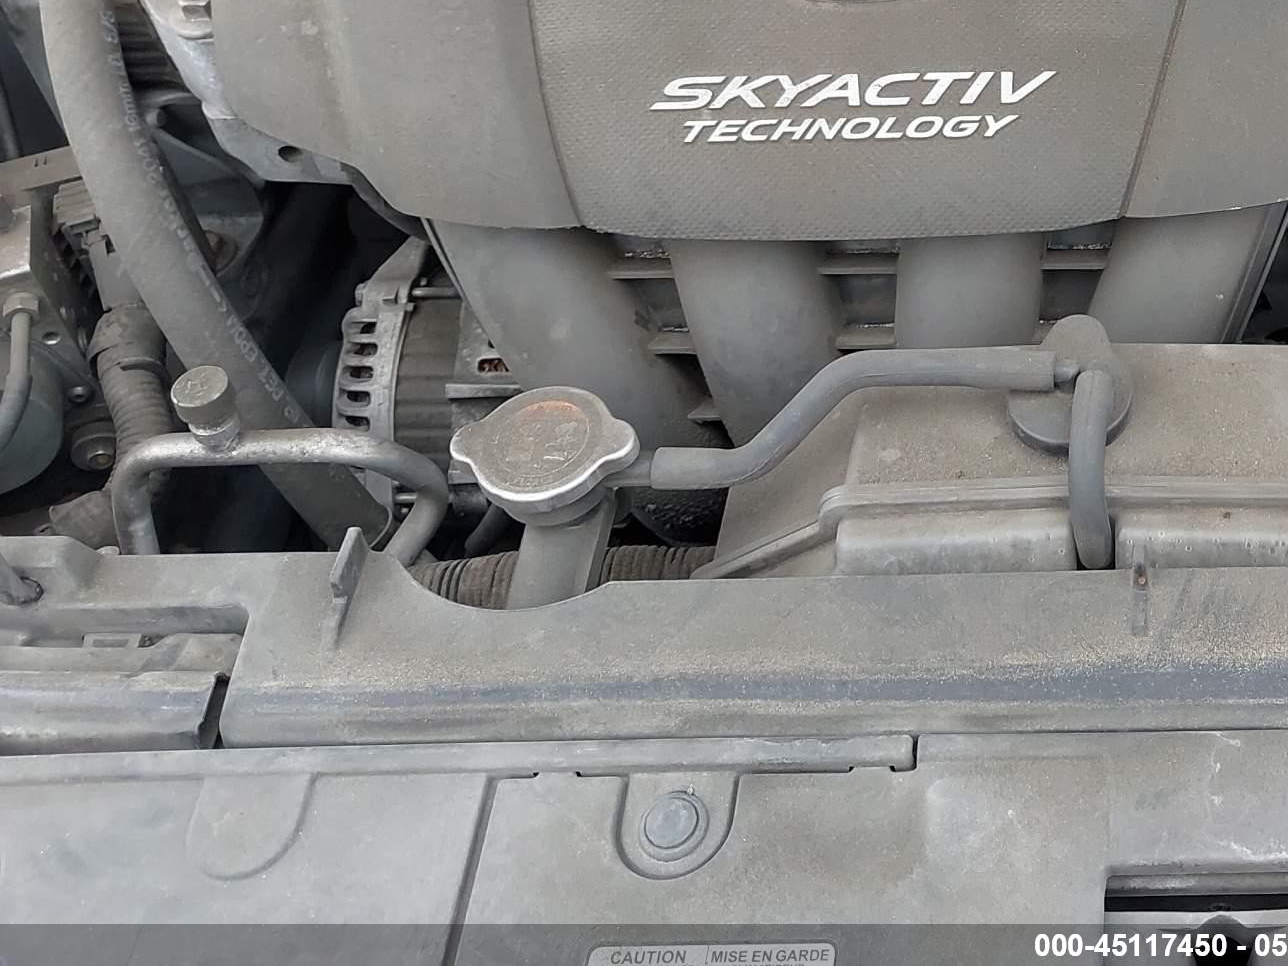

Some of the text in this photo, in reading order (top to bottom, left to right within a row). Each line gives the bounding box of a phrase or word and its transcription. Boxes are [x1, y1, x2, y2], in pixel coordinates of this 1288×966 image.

[650, 70, 1057, 111] SKYACTIV
[682, 114, 1022, 143] TECHNOLOGY
[609, 950, 687, 964] CAUTION
[710, 948, 830, 963] MISE EN GARDE
